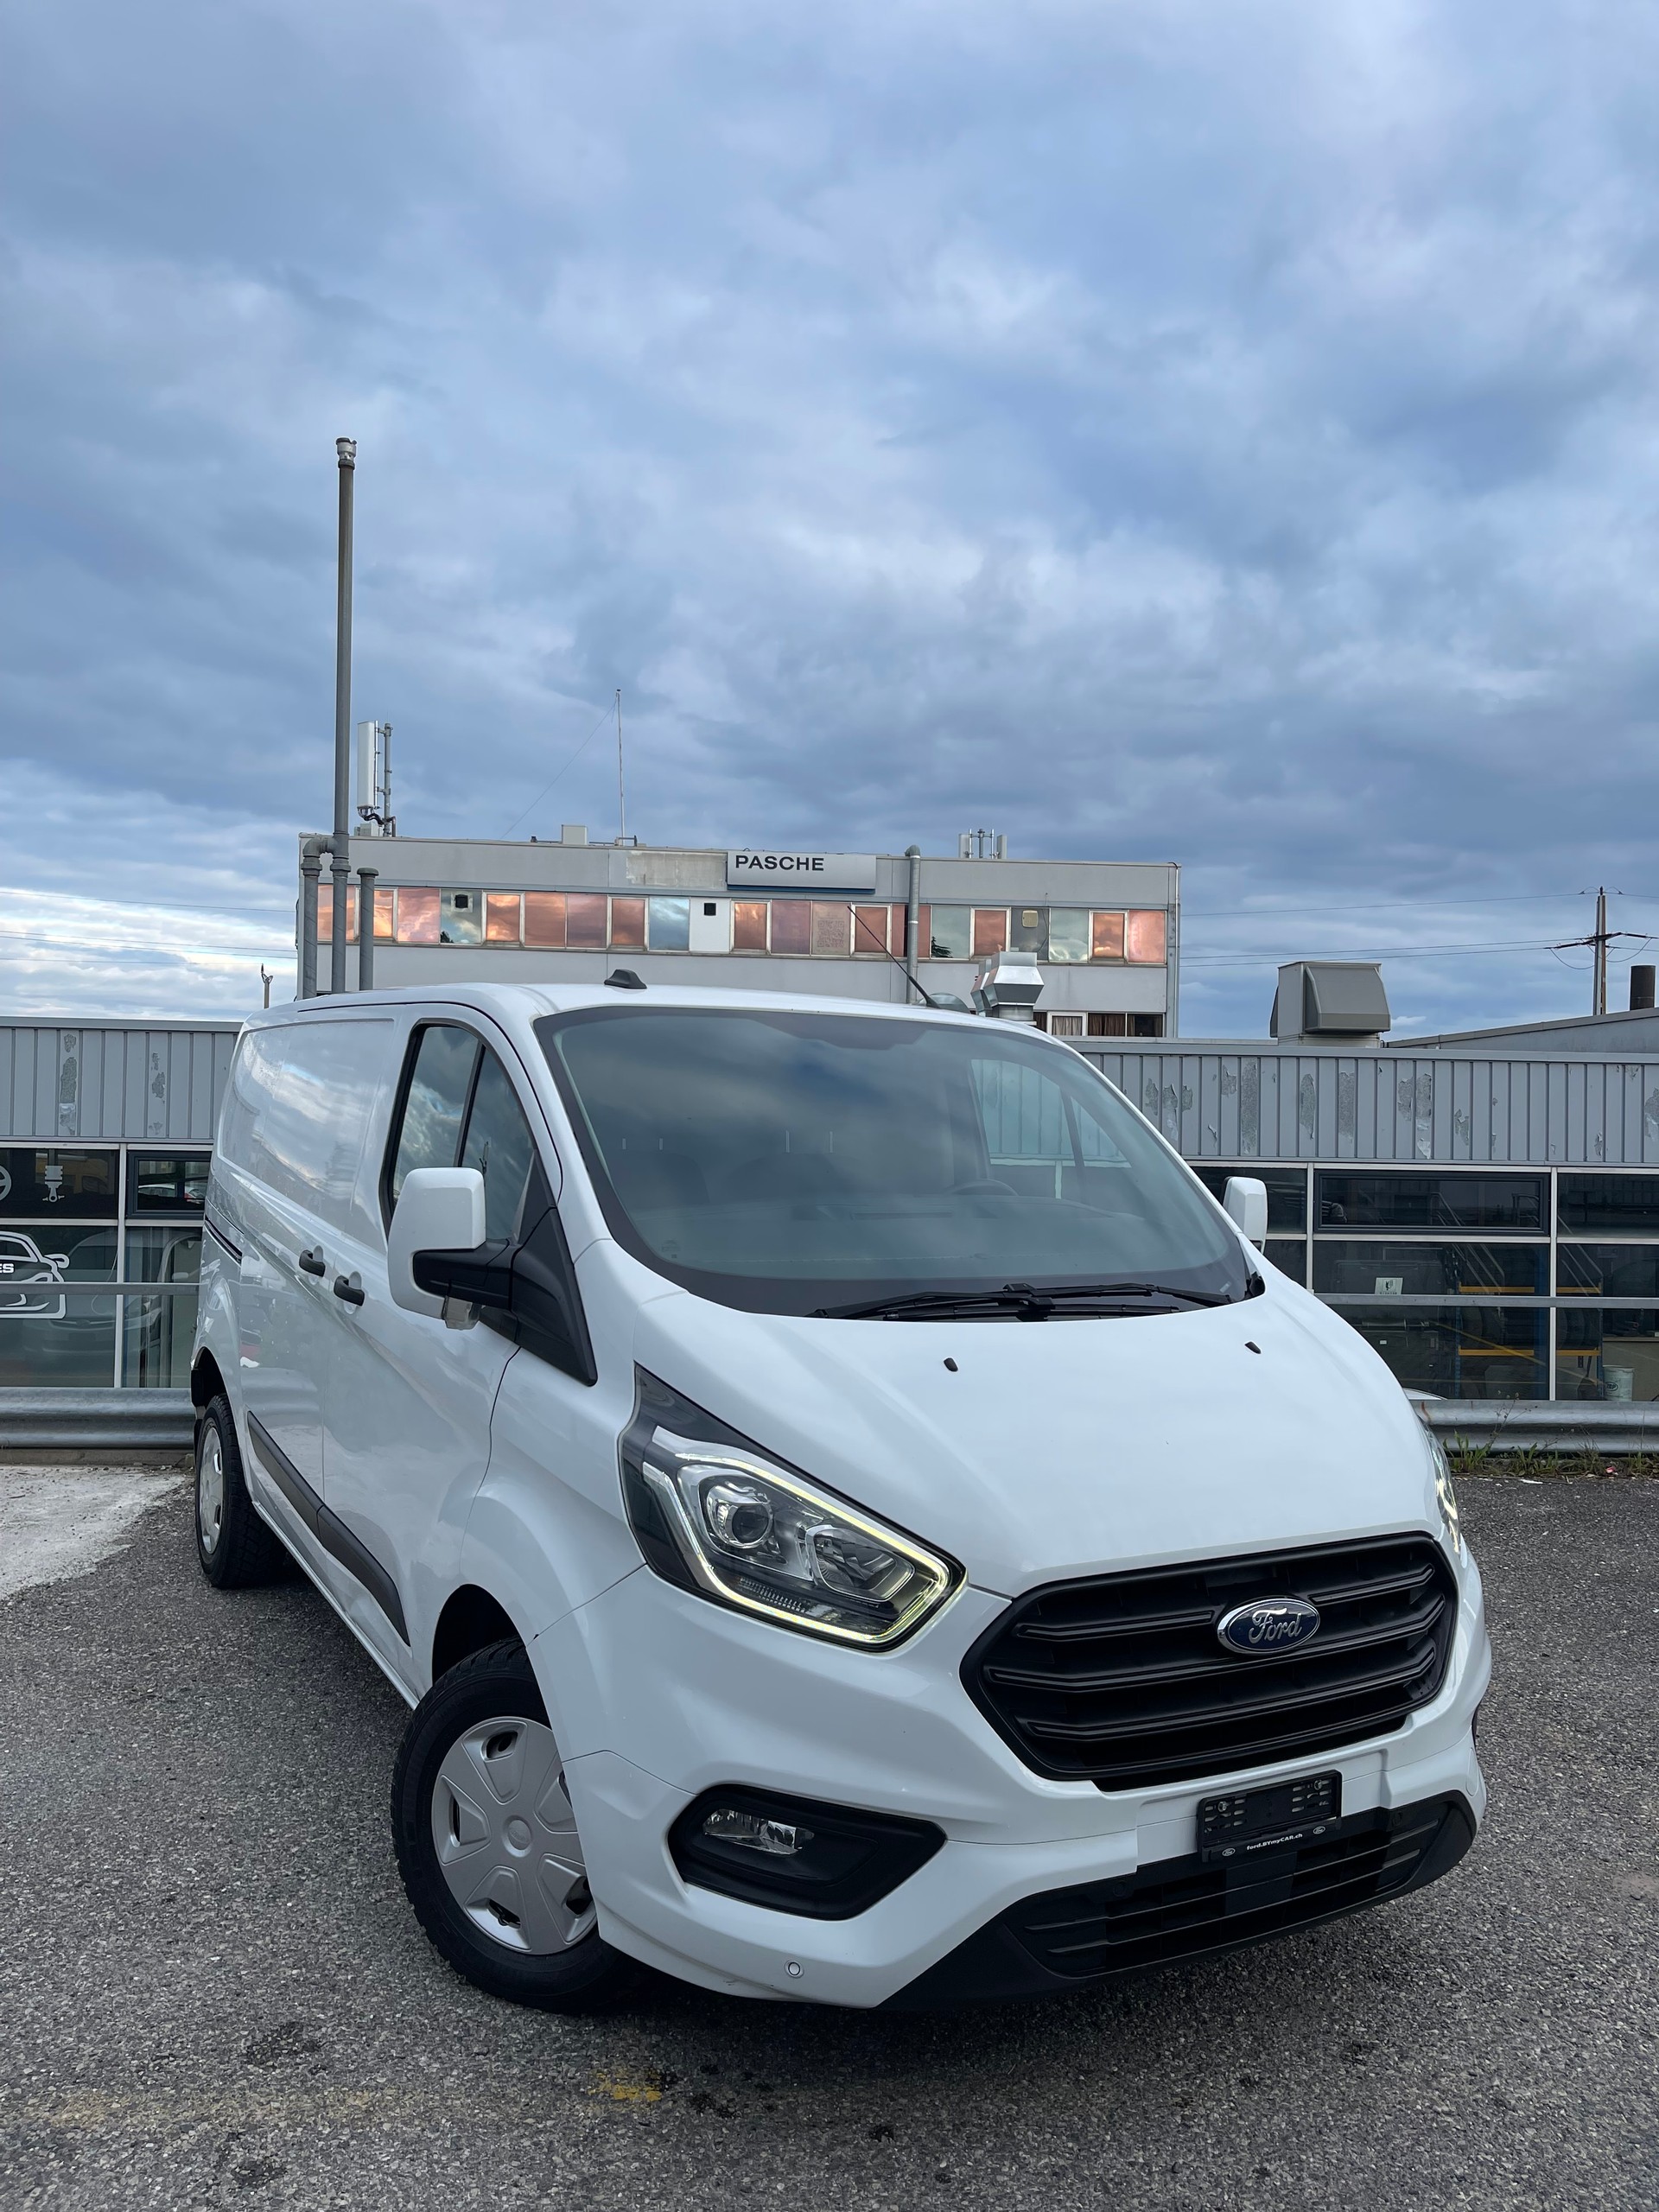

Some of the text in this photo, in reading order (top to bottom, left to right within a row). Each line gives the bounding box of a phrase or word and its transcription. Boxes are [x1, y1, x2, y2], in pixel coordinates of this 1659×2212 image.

[735, 855, 824, 871] PASCHE
[1249, 1608, 1302, 1644] Ford
[1246, 1833, 1303, 1851] ford.BYmyCAR.ch
